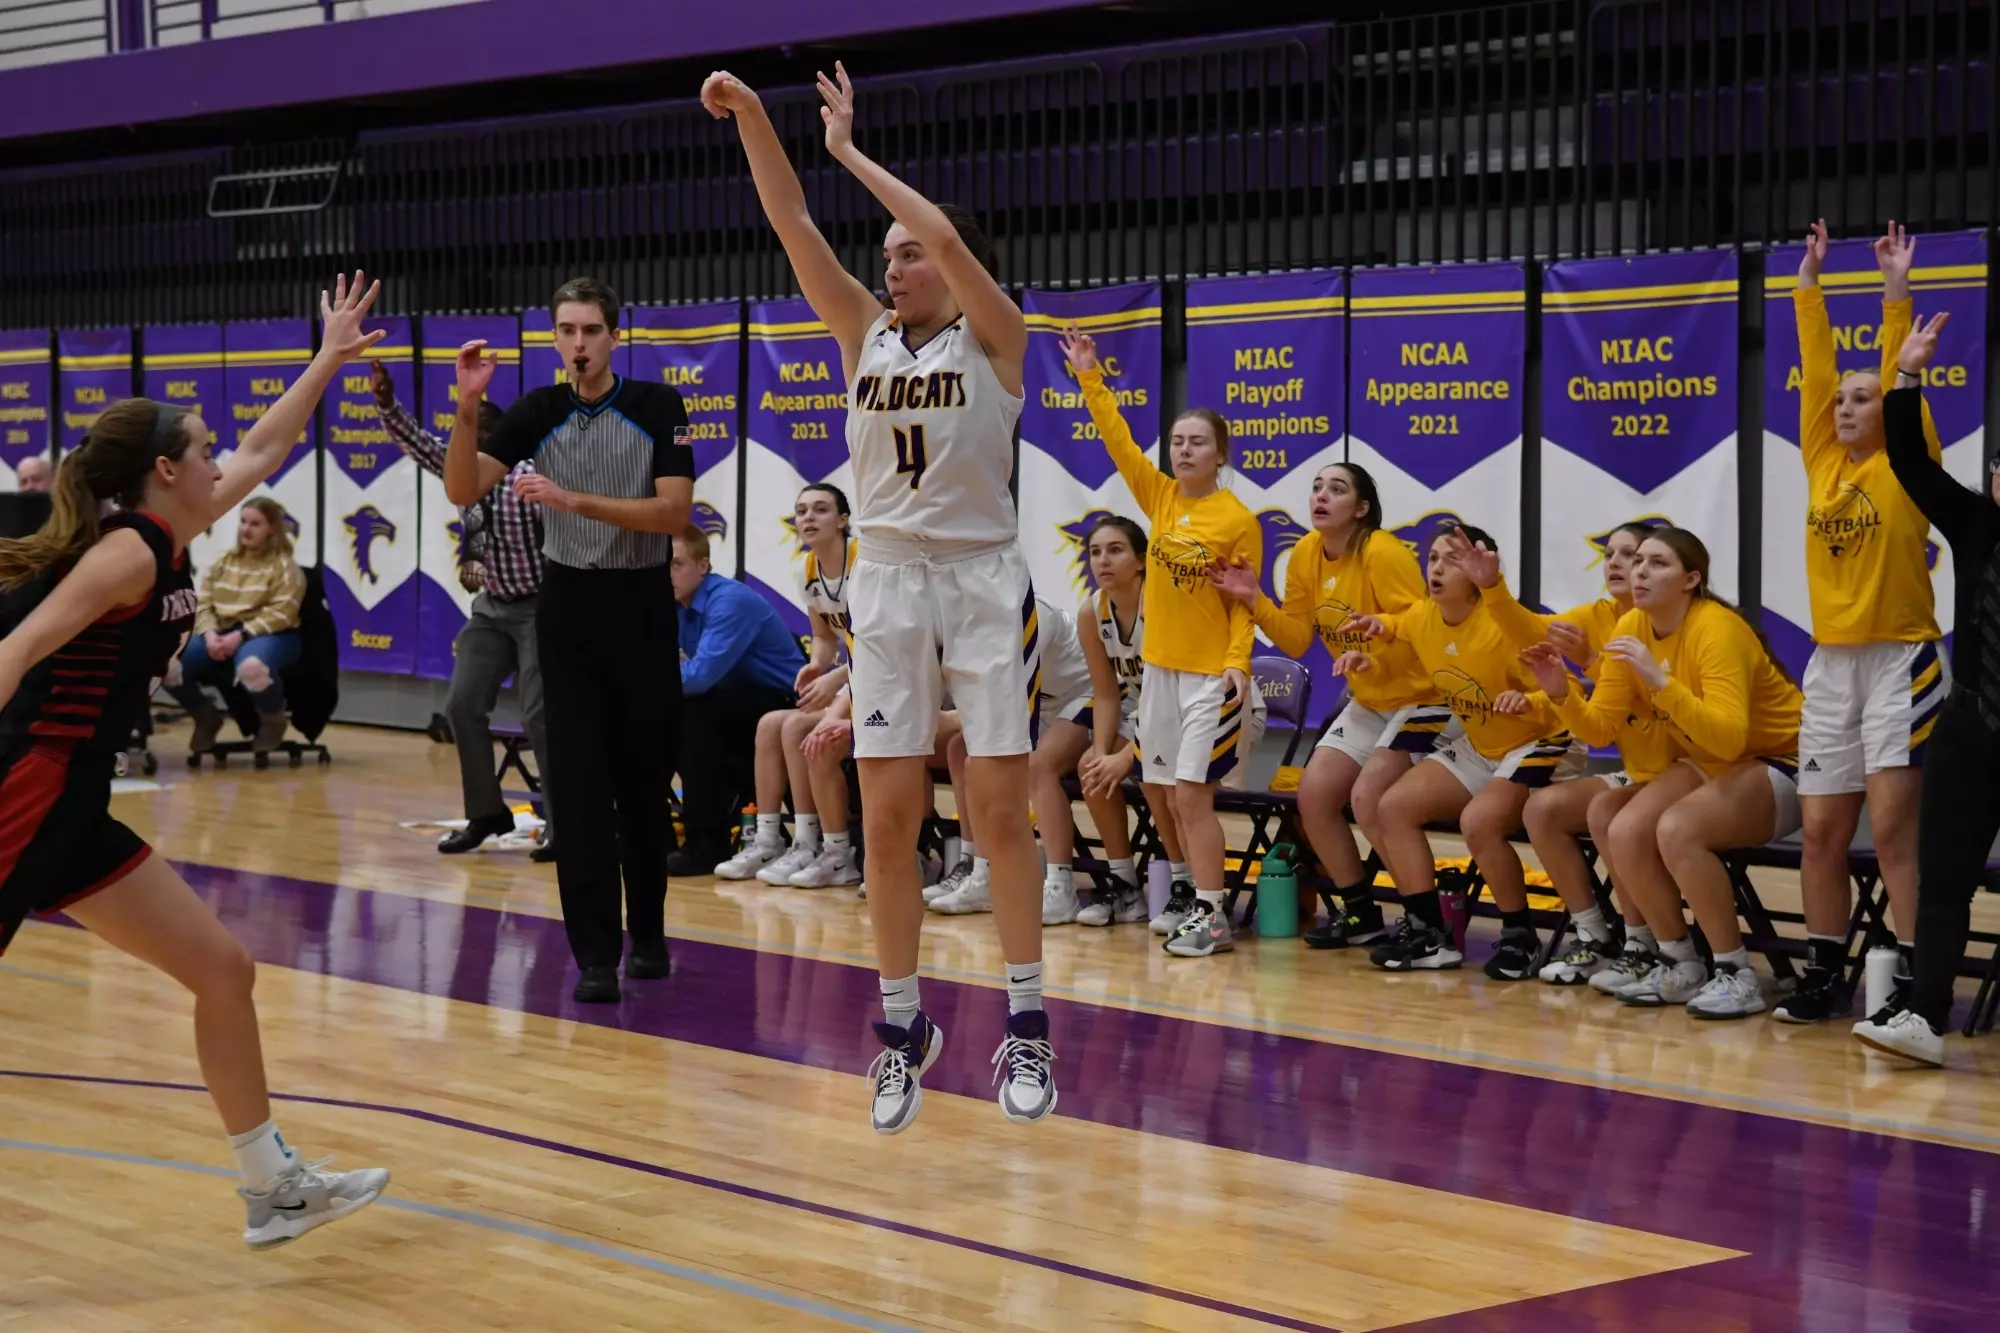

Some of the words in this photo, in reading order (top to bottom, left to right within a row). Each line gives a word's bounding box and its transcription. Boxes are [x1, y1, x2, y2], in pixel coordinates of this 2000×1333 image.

[1235, 345, 1294, 371] MIAC
[1400, 341, 1470, 367] NCAA
[1600, 335, 1674, 364] MIAC
[779, 361, 830, 382] NCAA
[74, 387, 106, 404] NCAA
[166, 381, 198, 398] MIAC
[251, 378, 285, 396] NCAA
[344, 376, 372, 393] MIA
[856, 371, 966, 413] WILDCATS
[1226, 378, 1304, 408] Playoff
[1365, 377, 1510, 407] Appearance
[1567, 372, 1718, 405] Champions
[340, 401, 379, 422] Playo
[683, 393, 737, 418] pions
[759, 391, 848, 416] Appearanc
[690, 422, 729, 440] 2021
[791, 422, 829, 440] 2021
[1224, 413, 1330, 441] hampions
[1408, 414, 1460, 436] 2021
[1611, 413, 1671, 437] 2022
[349, 453, 377, 469] 2017
[891, 422, 928, 492] 4
[1242, 449, 1288, 470] 2021
[351, 629, 393, 650] Soccer
